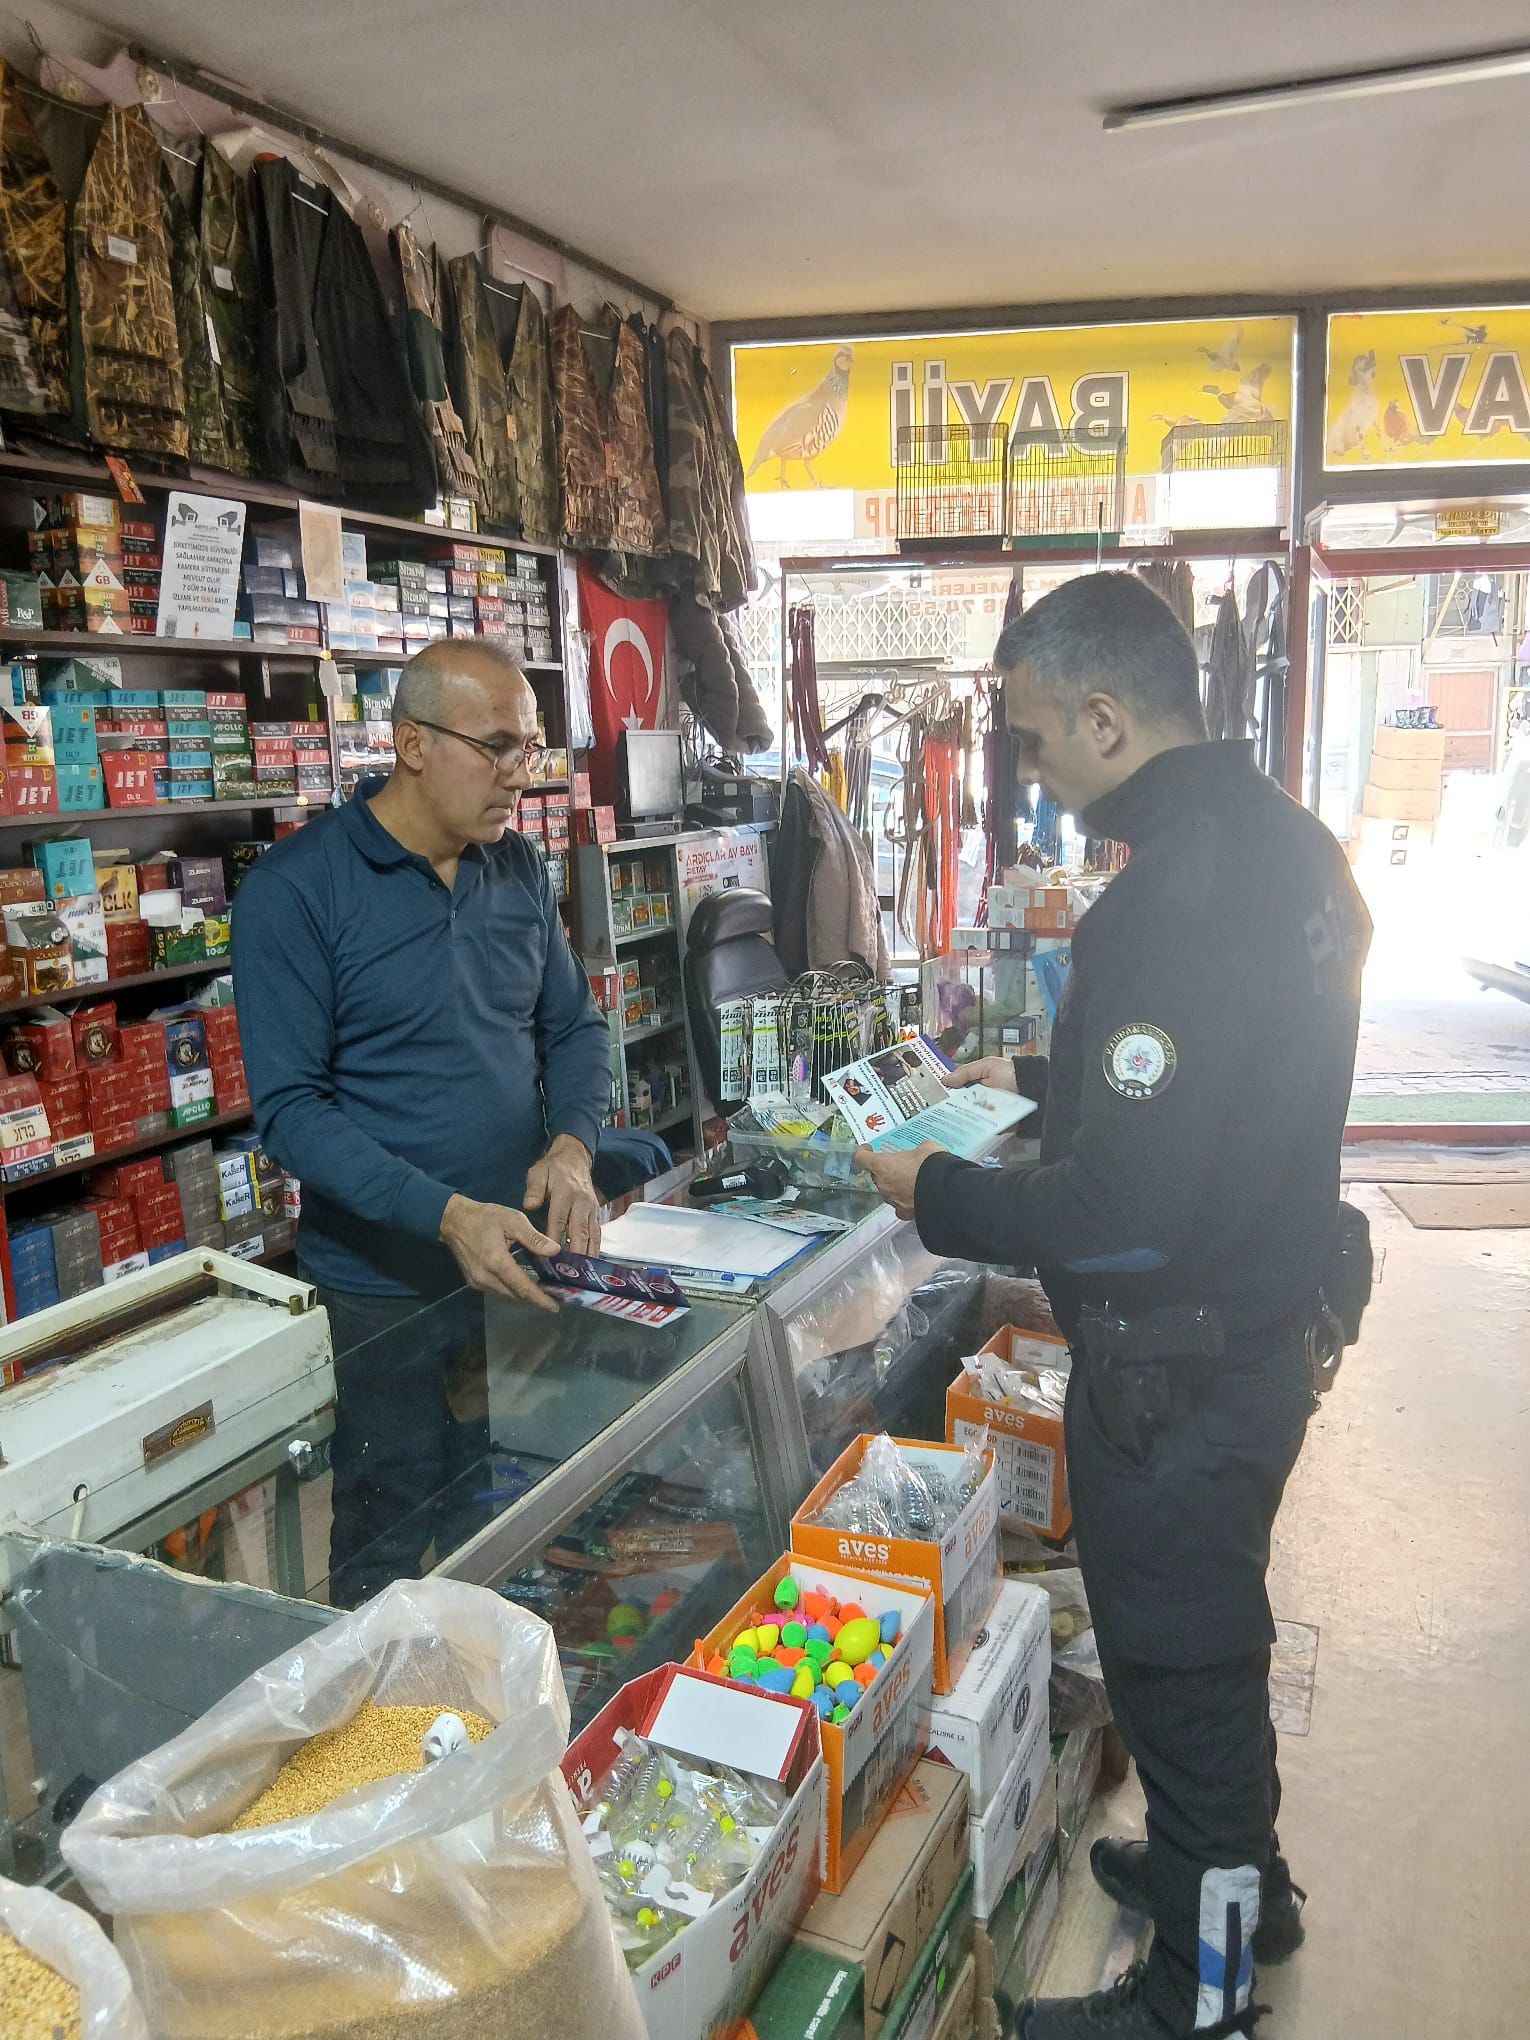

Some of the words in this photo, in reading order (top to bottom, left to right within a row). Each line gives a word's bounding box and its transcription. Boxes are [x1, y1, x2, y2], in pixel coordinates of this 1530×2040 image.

[123, 554, 141, 566] JET
[95, 574, 111, 586] GB
[128, 586, 145, 598] JET
[131, 618, 149, 630] JET
[118, 693, 136, 703] JET
[210, 695, 228, 706] JET
[128, 724, 146, 736] JET
[174, 723, 191, 734] JET
[294, 724, 310, 734] JET
[54, 726, 90, 745] JET
[261, 754, 276, 764] JET
[300, 752, 314, 762] JET
[114, 770, 148, 788] JET
[65, 784, 97, 803] JET
[177, 784, 192, 794] JET
[16, 786, 52, 806] JET
[55, 859, 86, 879] JET
[102, 890, 132, 912] CLK
[191, 896, 214, 905] ZUBER
[182, 1101, 211, 1118] APOLLO
[983, 1405, 1025, 1430] aves
[964, 1506, 990, 1560] aves
[838, 1537, 891, 1562] aves
[872, 1658, 911, 1735] aves
[729, 1824, 800, 1963] aves
